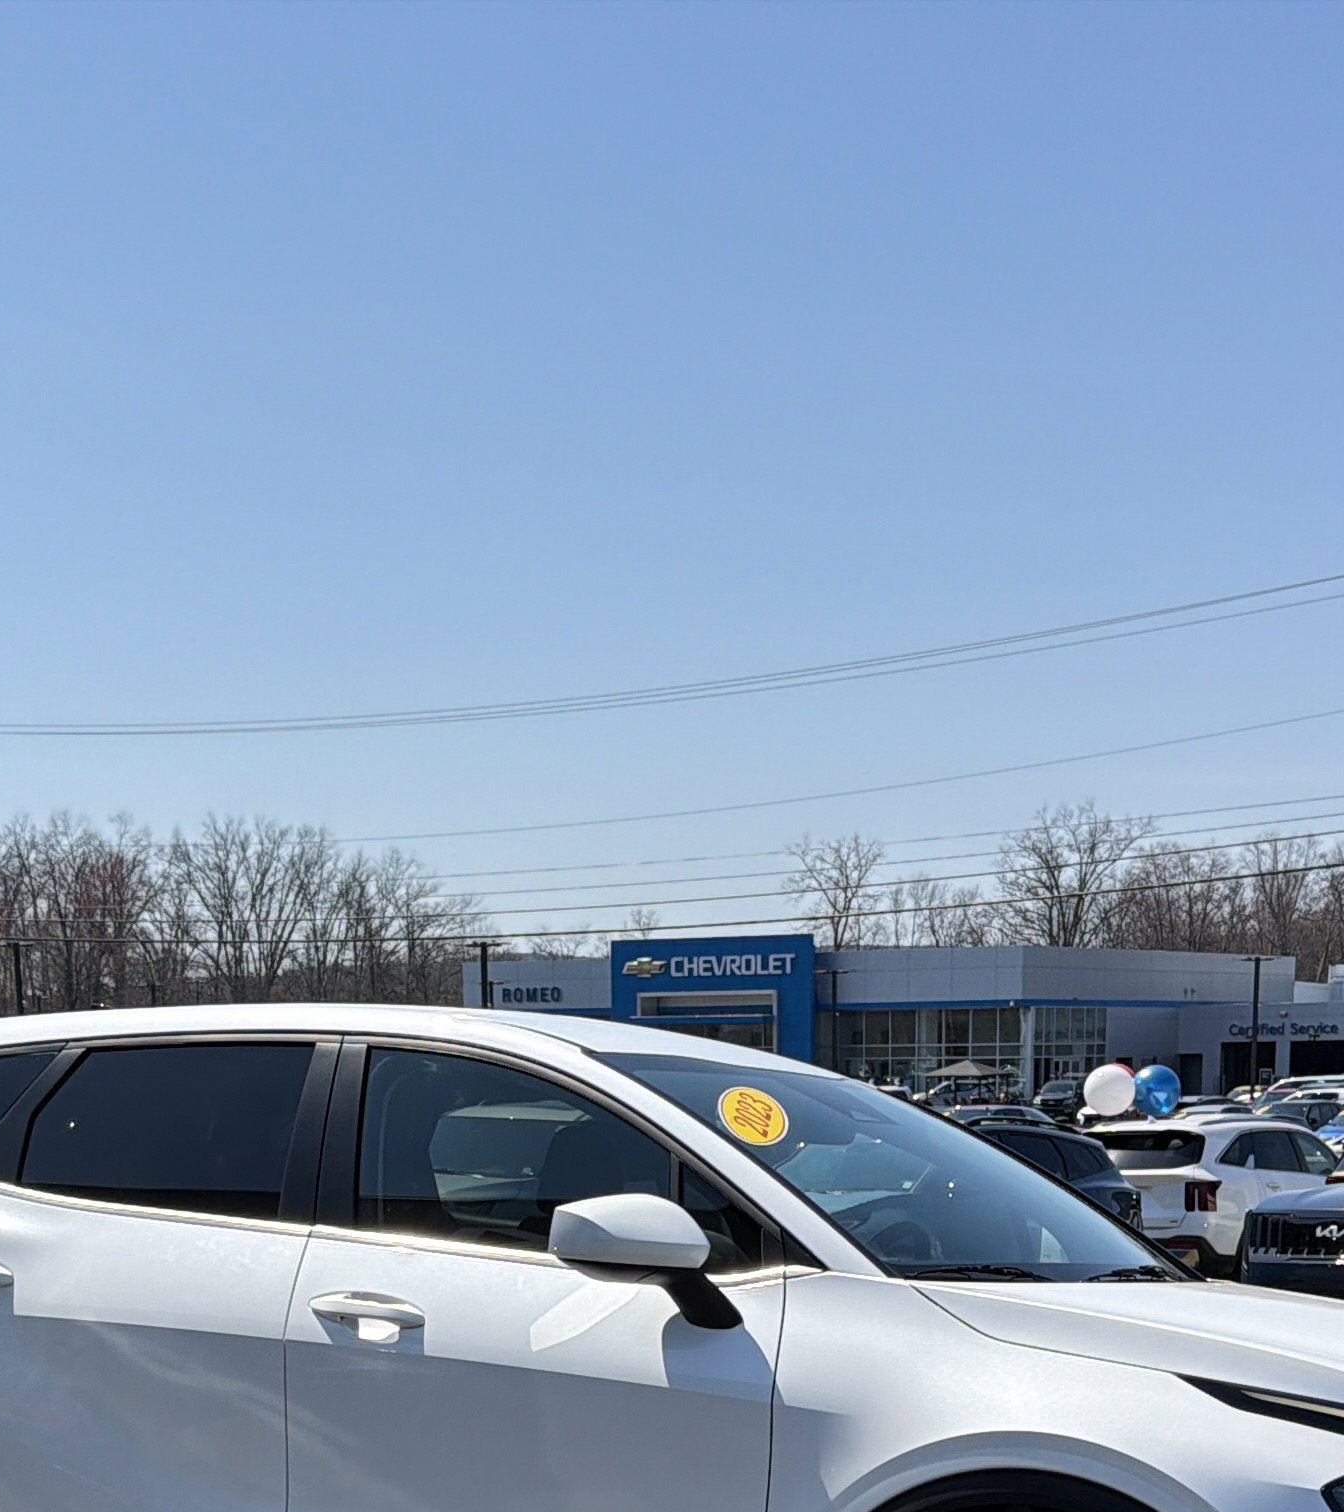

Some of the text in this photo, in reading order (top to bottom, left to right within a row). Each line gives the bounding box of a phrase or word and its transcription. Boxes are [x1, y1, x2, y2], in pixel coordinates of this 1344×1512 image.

[670, 954, 796, 977] CHEVROLET
[502, 986, 561, 1003] ROMEO
[1291, 1022, 1338, 1035] Service
[734, 1092, 773, 1139] 2023
